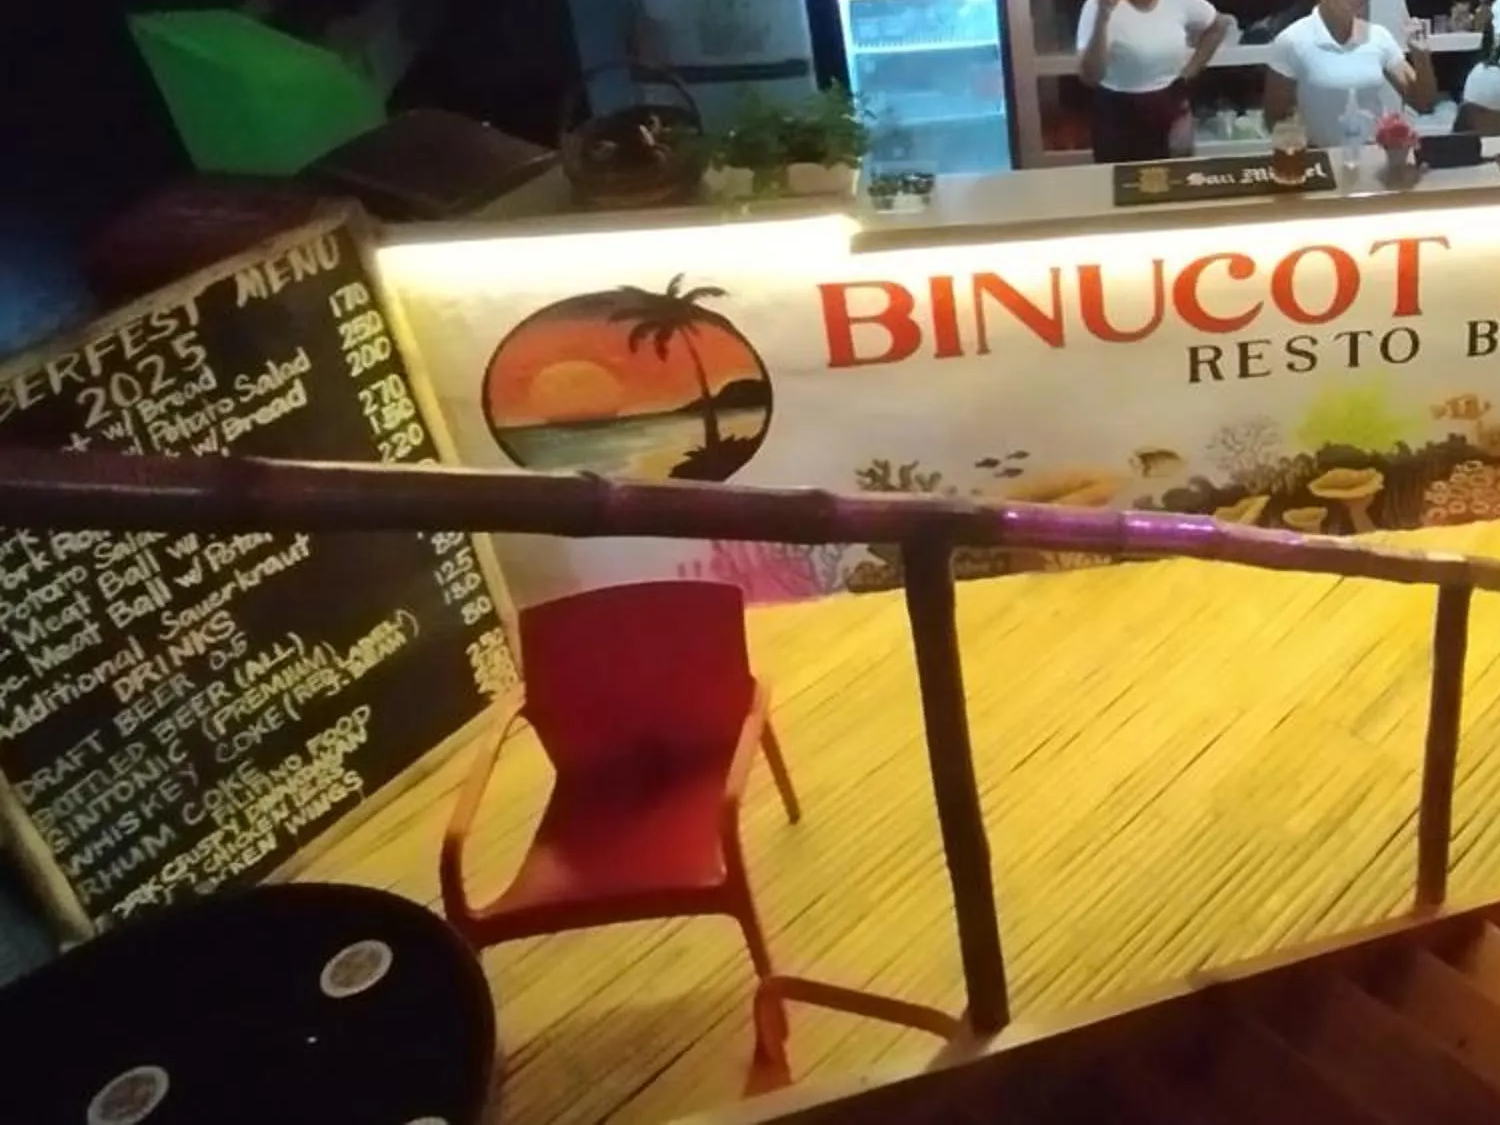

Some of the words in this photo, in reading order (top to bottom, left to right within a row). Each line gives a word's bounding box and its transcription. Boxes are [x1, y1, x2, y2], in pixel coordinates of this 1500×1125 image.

[235, 235, 340, 308] MENU
[818, 236, 1450, 369] BINUCOT
[75, 330, 206, 429] 2025
[221, 378, 308, 442] Bread
[346, 335, 392, 378] 200
[235, 346, 312, 404] Salad
[1189, 325, 1421, 384] RESTO
[136, 364, 218, 424] Bread
[358, 374, 406, 416] 270
[93, 530, 168, 570] Sala
[433, 546, 474, 586] 125
[11, 590, 92, 652] Meat
[97, 547, 162, 601] Ball
[25, 619, 103, 679] Meat
[105, 575, 173, 629] Ball
[0, 634, 146, 740] dditional
[112, 608, 237, 703] DRINKS
[14, 729, 104, 806] DRAFT
[111, 673, 197, 737] BEER
[150, 681, 233, 745] BEER
[214, 705, 286, 764] COKE
[306, 704, 372, 751] FOOD
[181, 758, 259, 827] COKE
